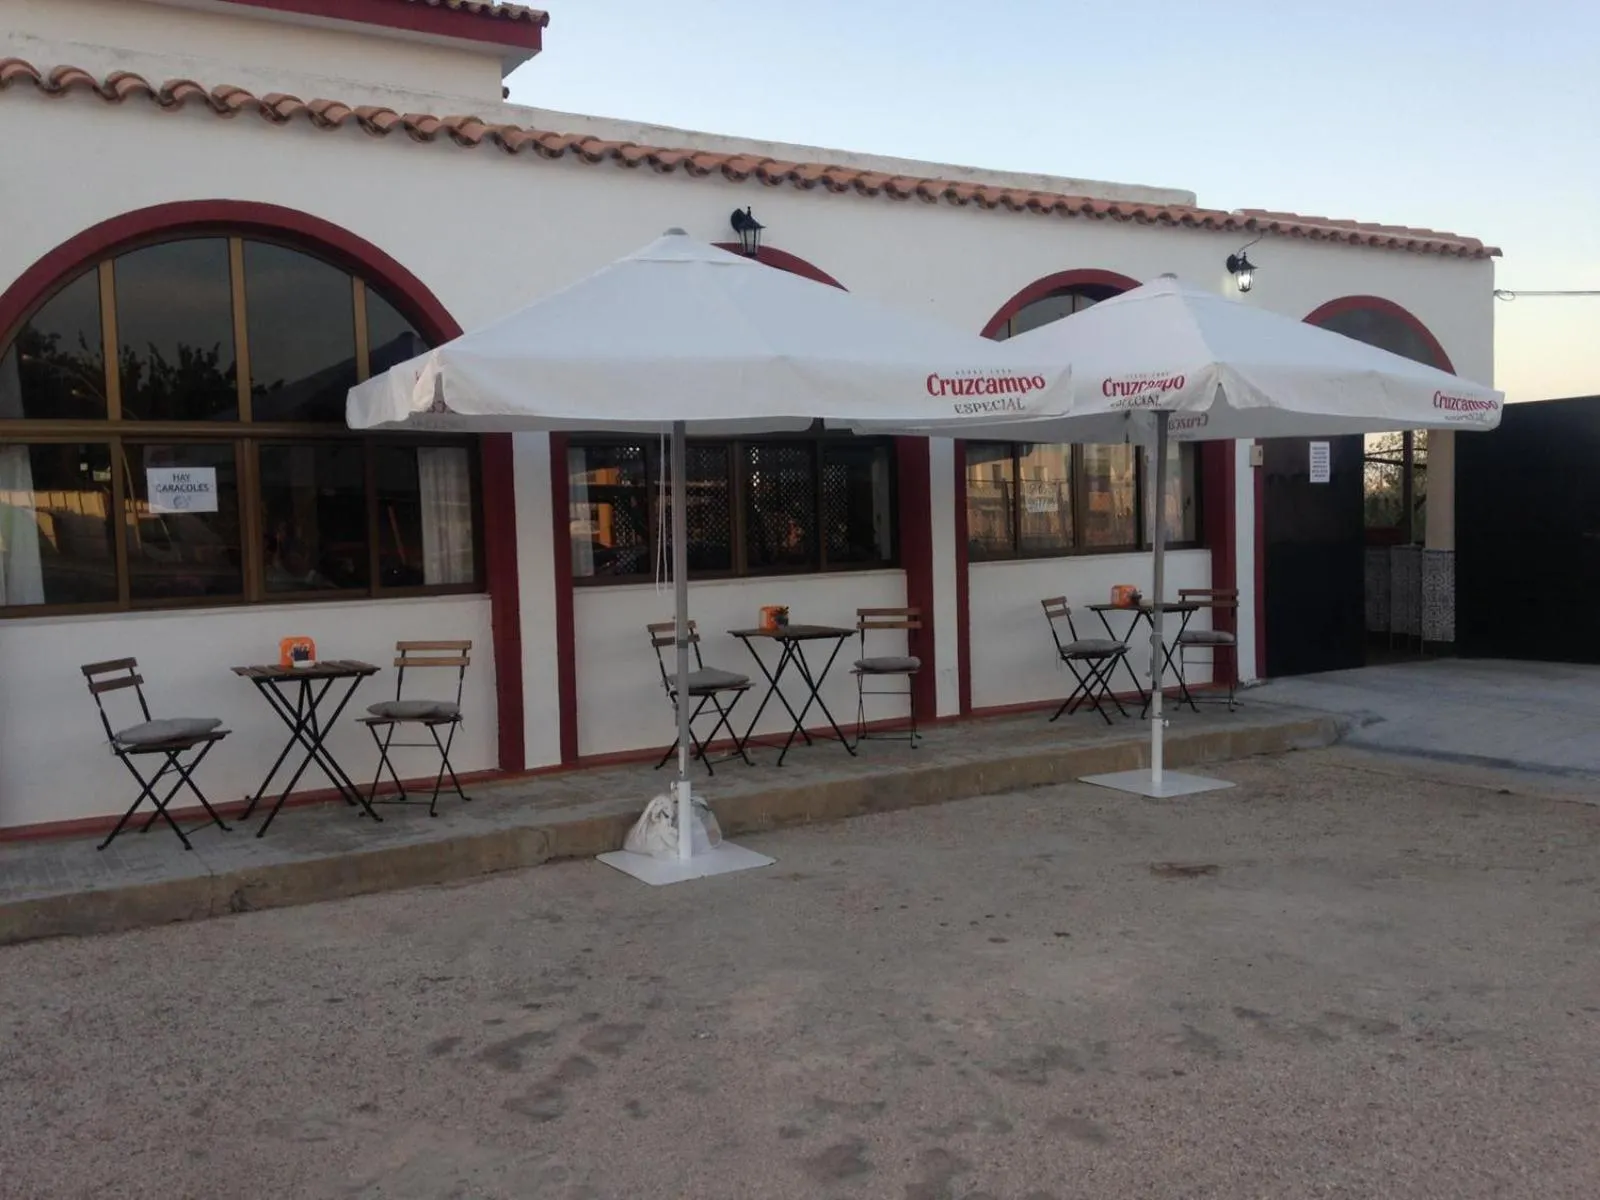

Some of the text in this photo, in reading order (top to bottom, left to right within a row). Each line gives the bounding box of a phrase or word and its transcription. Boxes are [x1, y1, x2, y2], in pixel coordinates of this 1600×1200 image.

[926, 372, 1046, 397] Cruzcampo
[953, 398, 1026, 415] ESPECIAL
[1110, 394, 1162, 409] ECIAL
[172, 473, 191, 482] HAY
[155, 483, 210, 493] CARACOLES
